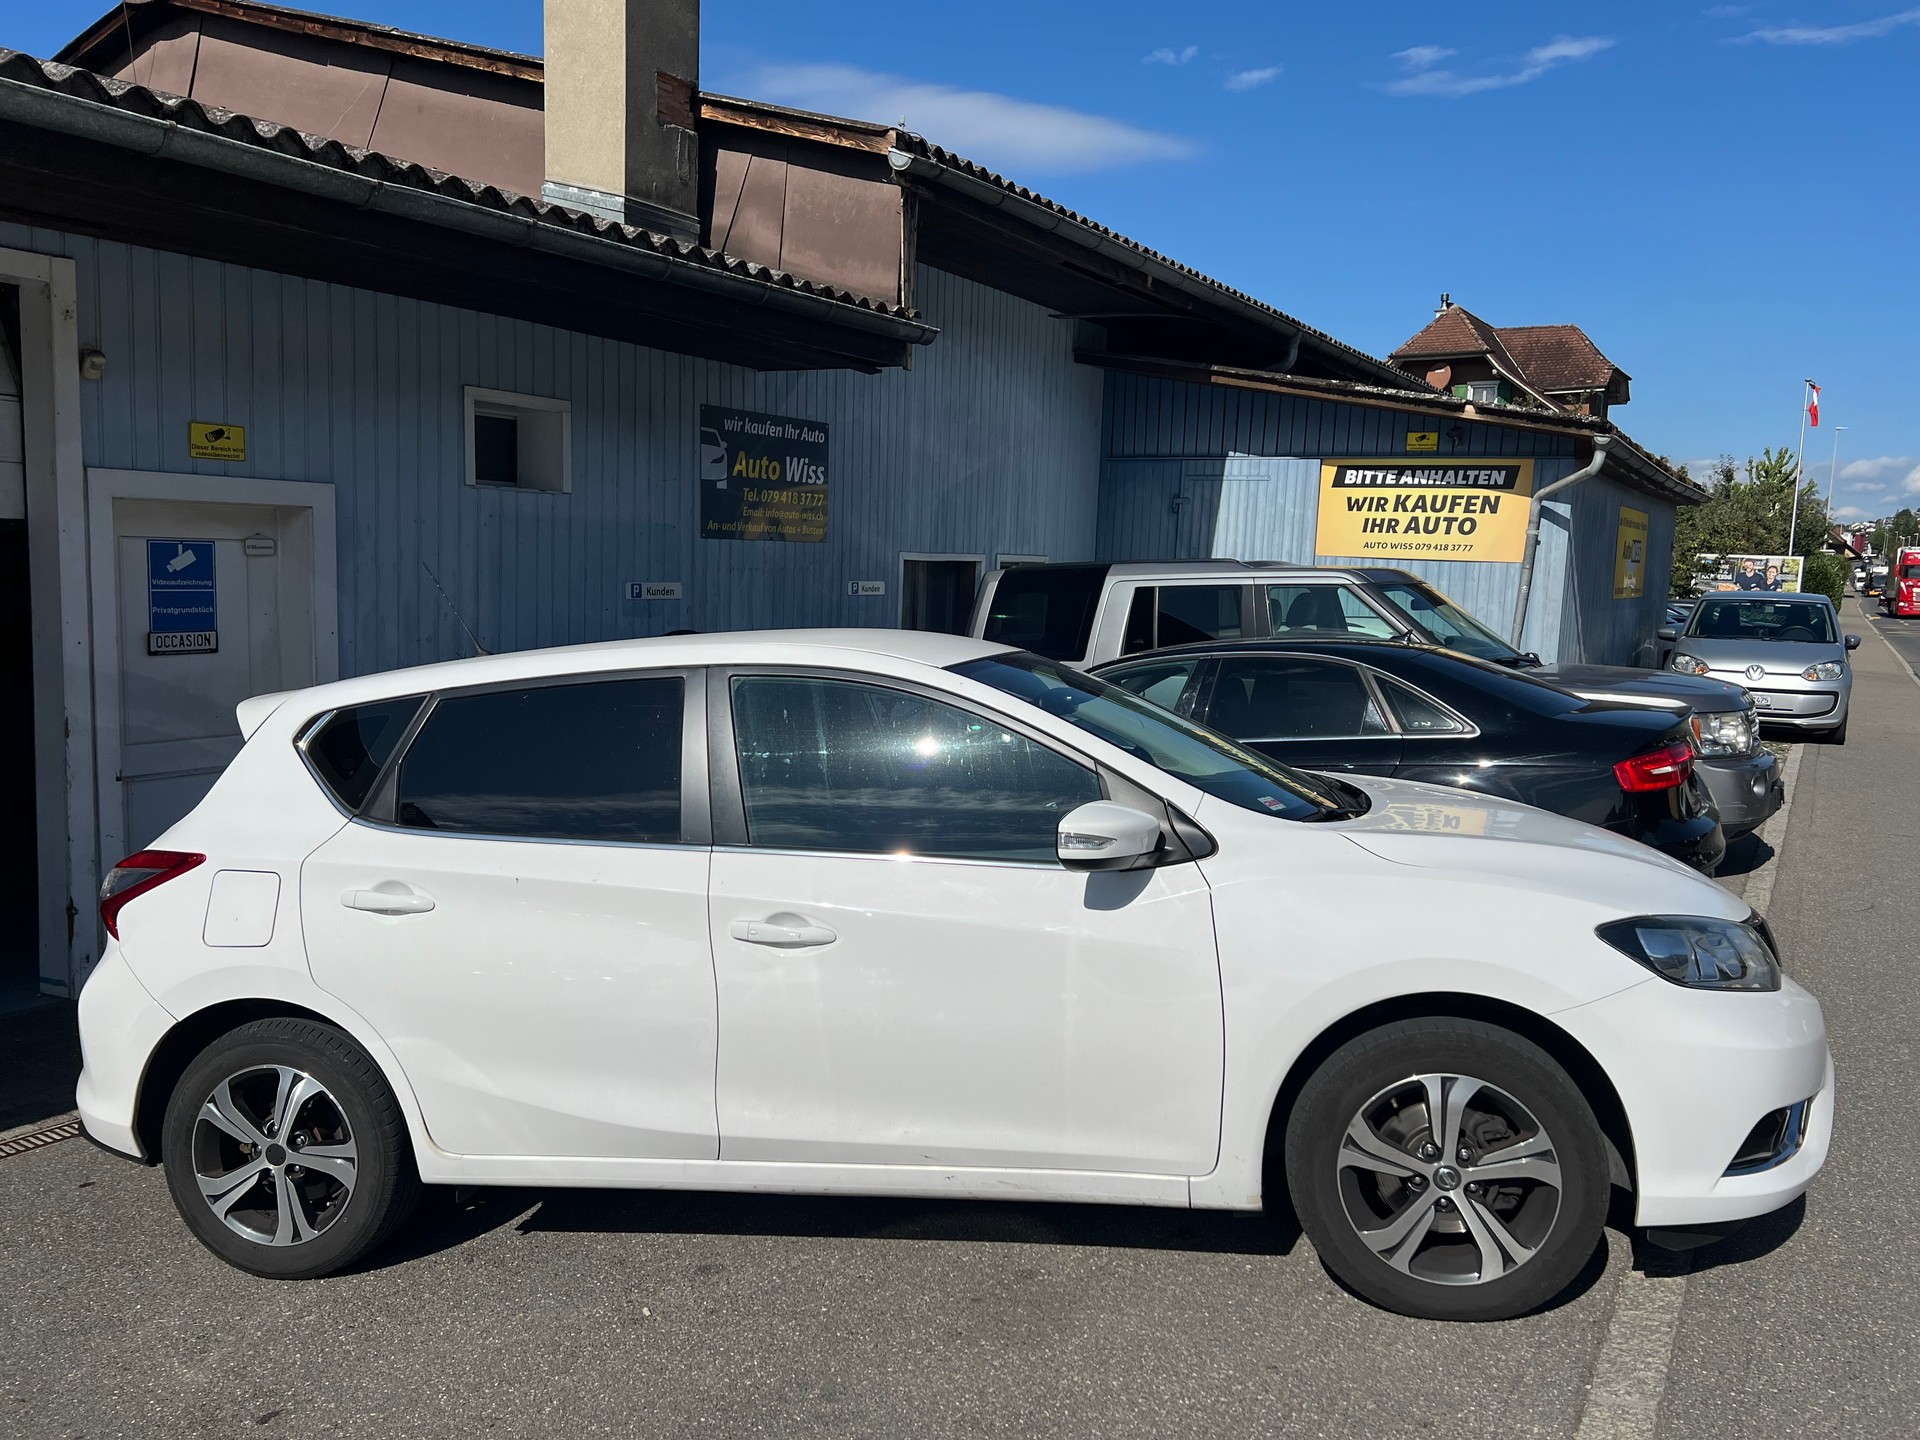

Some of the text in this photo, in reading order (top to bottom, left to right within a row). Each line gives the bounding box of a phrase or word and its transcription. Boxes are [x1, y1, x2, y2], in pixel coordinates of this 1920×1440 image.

[724, 416, 825, 444] wir kaufen Ihr Auto
[732, 450, 825, 485] Auto Wiss
[1344, 470, 1506, 485] BITTE ANHALTEN
[743, 488, 824, 506] Tel. 079 418 37 77
[1346, 494, 1501, 514] WIR KAUFEN
[743, 506, 824, 520] Email: info@auto-wiss.ch
[708, 520, 720, 530] An-
[722, 521, 736, 531] und
[738, 522, 764, 532] Verkauf
[764, 524, 776, 532] von
[778, 524, 796, 534] Autos
[802, 525, 824, 535] Bussen
[1362, 516, 1478, 536] IHR AUTO
[1363, 542, 1388, 550] AUTO
[1390, 542, 1414, 550] WISS
[1414, 542, 1432, 551] 079
[1433, 543, 1449, 551] 418
[646, 586, 674, 596] Kunden
[152, 606, 214, 615] Privatgrundstück
[156, 633, 211, 648] OCCASION
